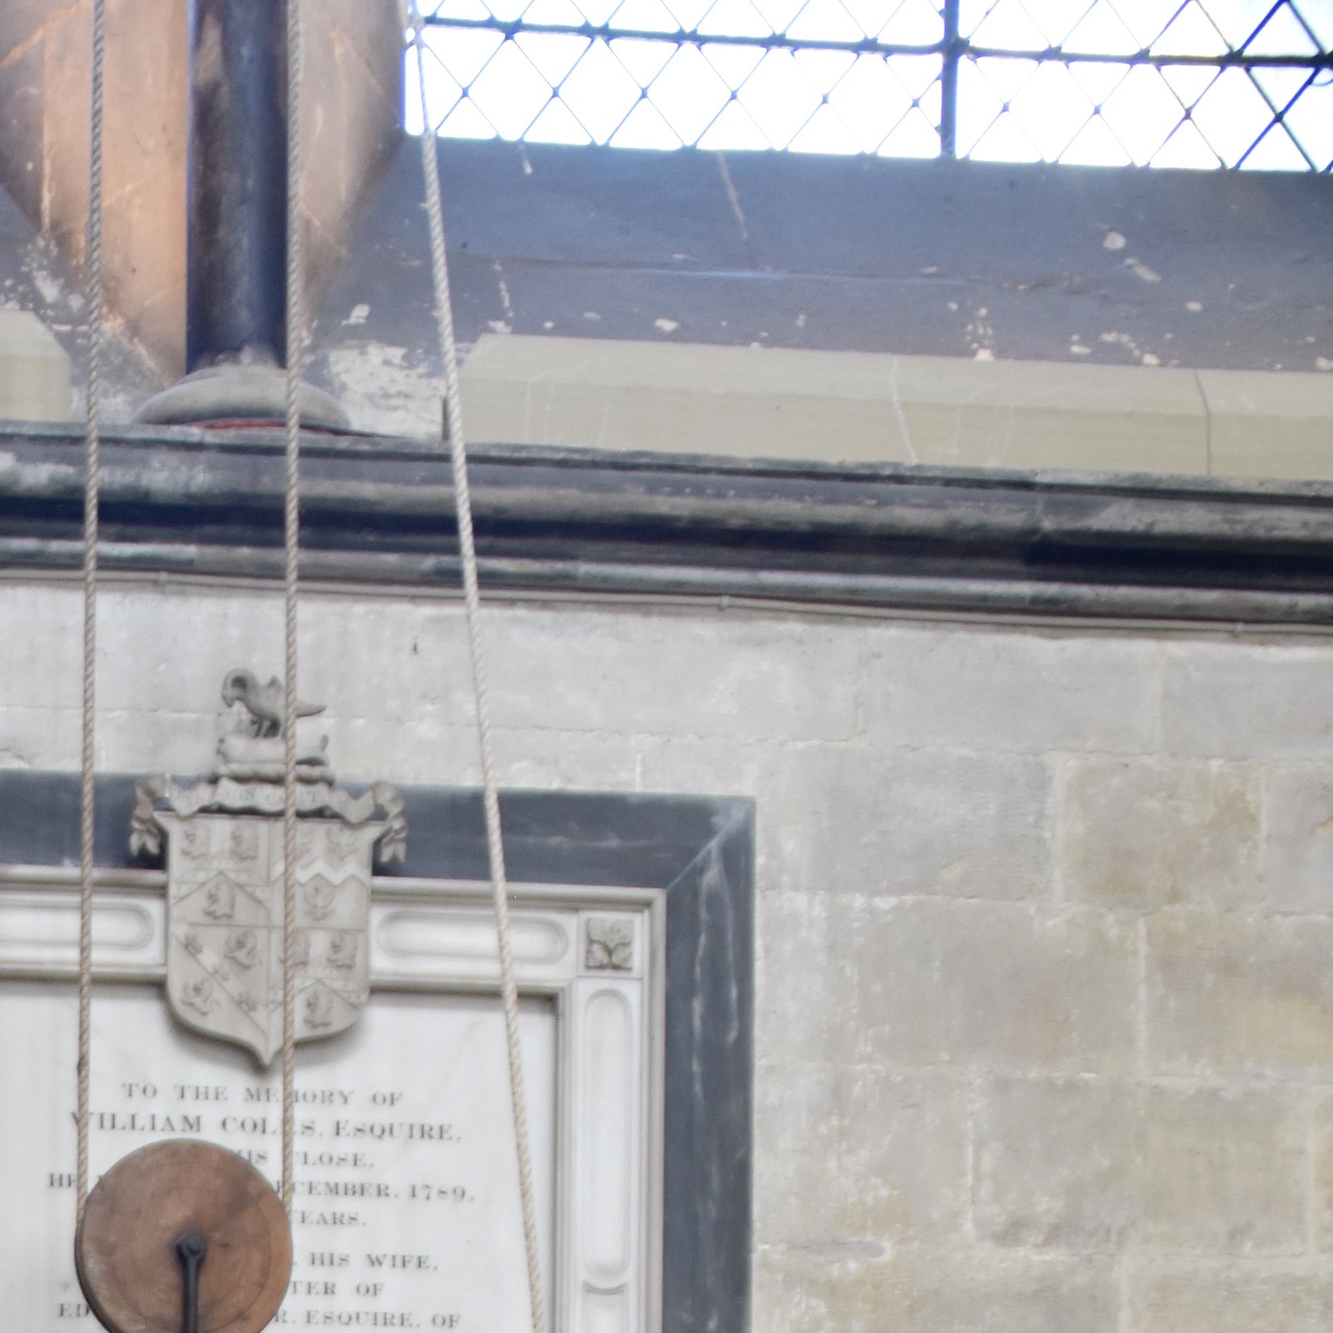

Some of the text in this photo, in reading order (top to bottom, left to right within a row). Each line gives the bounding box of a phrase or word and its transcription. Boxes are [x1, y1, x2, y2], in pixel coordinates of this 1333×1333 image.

[122, 1083, 157, 1099] TO
[174, 1084, 228, 1101] THE
[371, 1092, 403, 1106] OF
[310, 1252, 350, 1267] HIS
[355, 1282, 385, 1297] OF
[431, 1313, 462, 1328] OF
